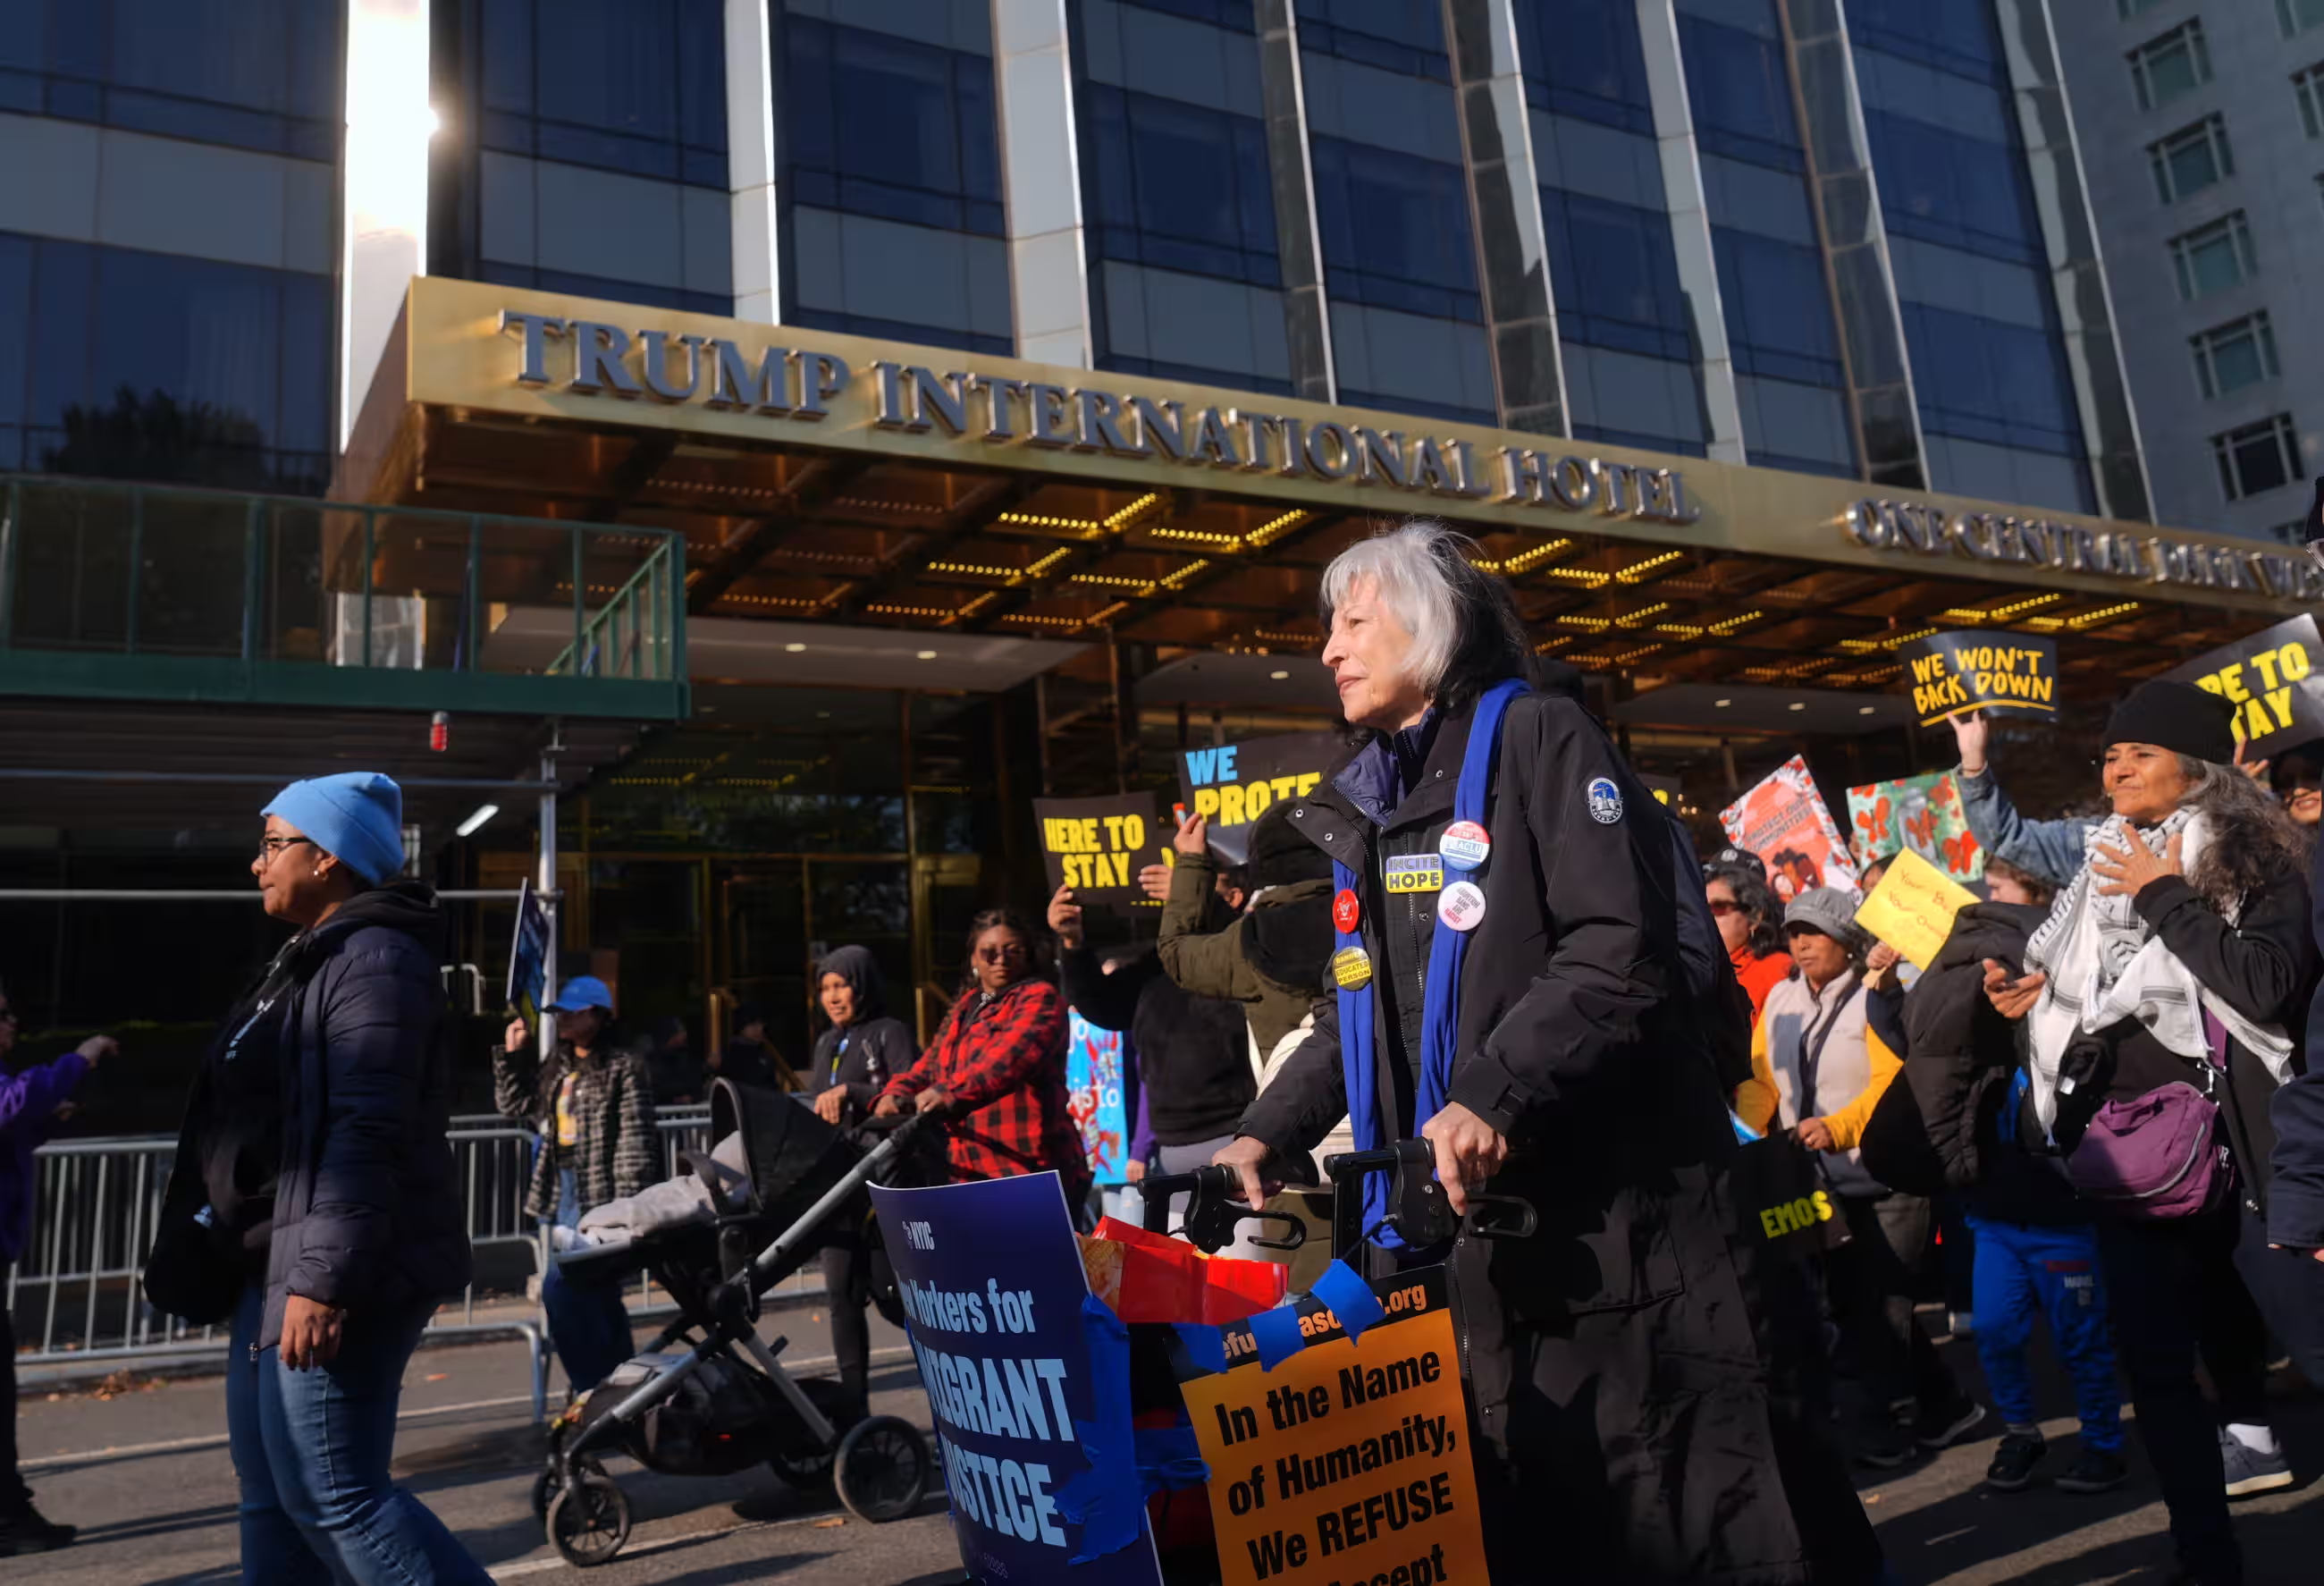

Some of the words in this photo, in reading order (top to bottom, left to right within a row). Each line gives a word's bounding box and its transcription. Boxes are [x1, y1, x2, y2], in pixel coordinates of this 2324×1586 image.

[497, 308, 852, 421] TRUMP
[875, 360, 1492, 497] INTERNATIONAL
[1499, 445, 1700, 523] HOTEL
[1845, 498, 1950, 553] ONE
[1911, 654, 1945, 684] WE
[1955, 646, 2044, 676] WON'T
[2250, 641, 2310, 691] TO
[1913, 673, 1966, 714] BACK
[1974, 671, 2052, 702] DOWN
[2230, 686, 2294, 744] AY
[1185, 746, 1238, 786] WE
[1043, 817, 1102, 854] HERE
[1103, 814, 1145, 851] TO
[1458, 839, 1482, 855] ACLU
[1062, 852, 1130, 888] STAY
[1389, 856, 1439, 871] INCITE
[1389, 872, 1440, 890] HOPE
[1336, 960, 1369, 977] EDUCATED
[1338, 969, 1370, 984] PERSON
[910, 1221, 935, 1250] NYIC
[1759, 1190, 1832, 1239] EMOS
[909, 1278, 988, 1334] Yorkers
[987, 1278, 1036, 1333] for
[914, 1338, 1075, 1442] MIGRANT
[1215, 1404, 1259, 1446] In
[1267, 1385, 1330, 1430] the
[1338, 1351, 1441, 1409] Name
[1228, 1465, 1265, 1516] of
[1276, 1413, 1456, 1499] Humanity,
[1247, 1531, 1308, 1581] We
[1317, 1472, 1453, 1556] REFUSE
